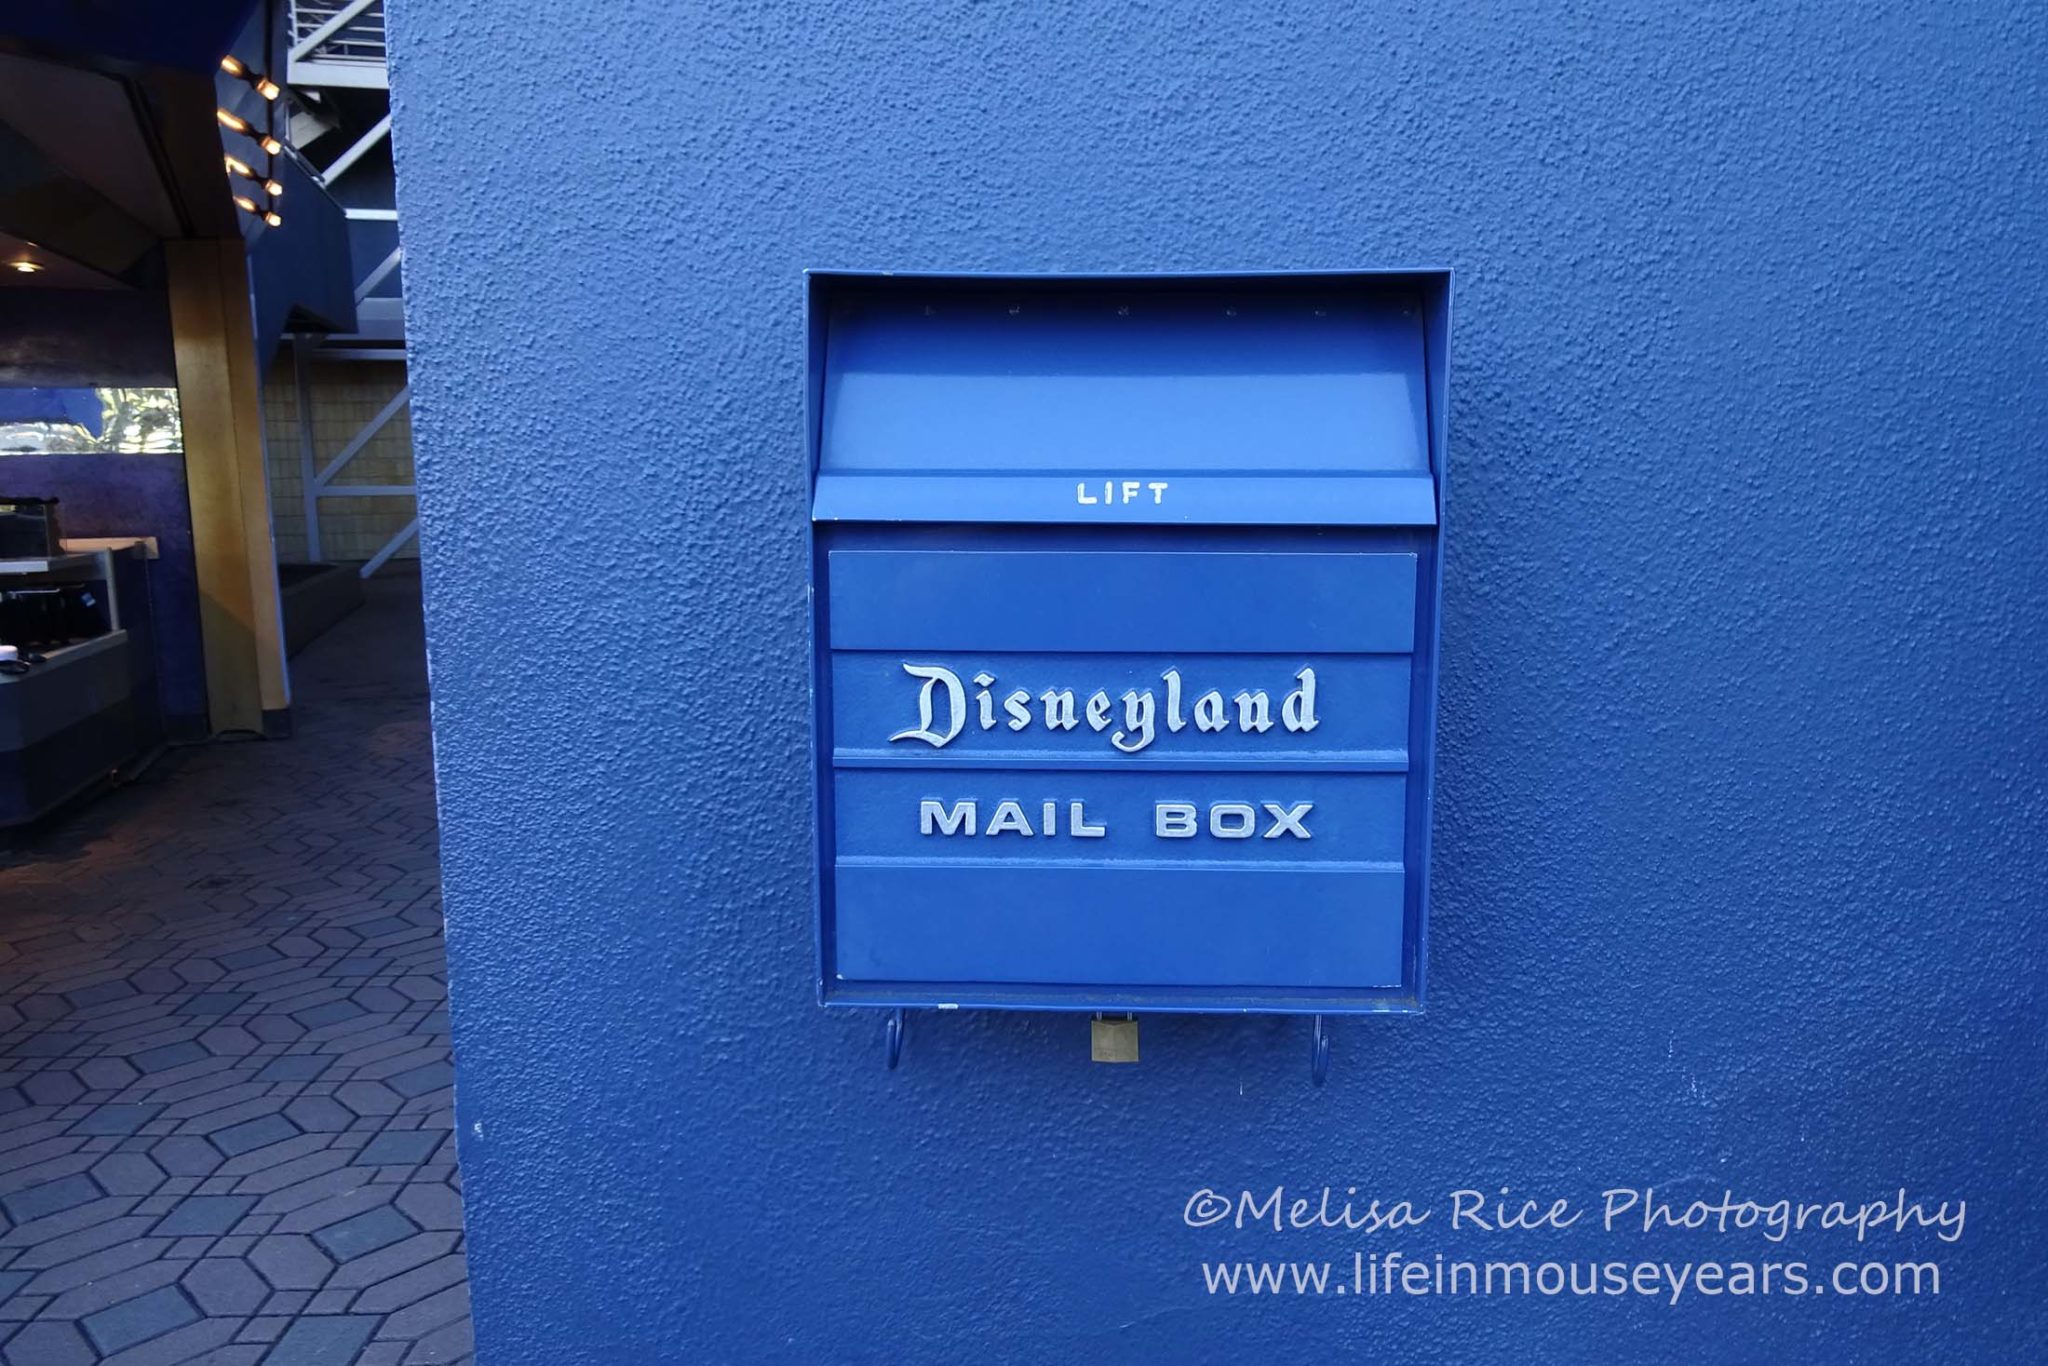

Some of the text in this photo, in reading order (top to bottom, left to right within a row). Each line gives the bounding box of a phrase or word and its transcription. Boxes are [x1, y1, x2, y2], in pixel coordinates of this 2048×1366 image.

[1076, 481, 1169, 505] LIFT
[889, 663, 1319, 752] Disneyland
[919, 799, 1314, 839] MAIL BOX
